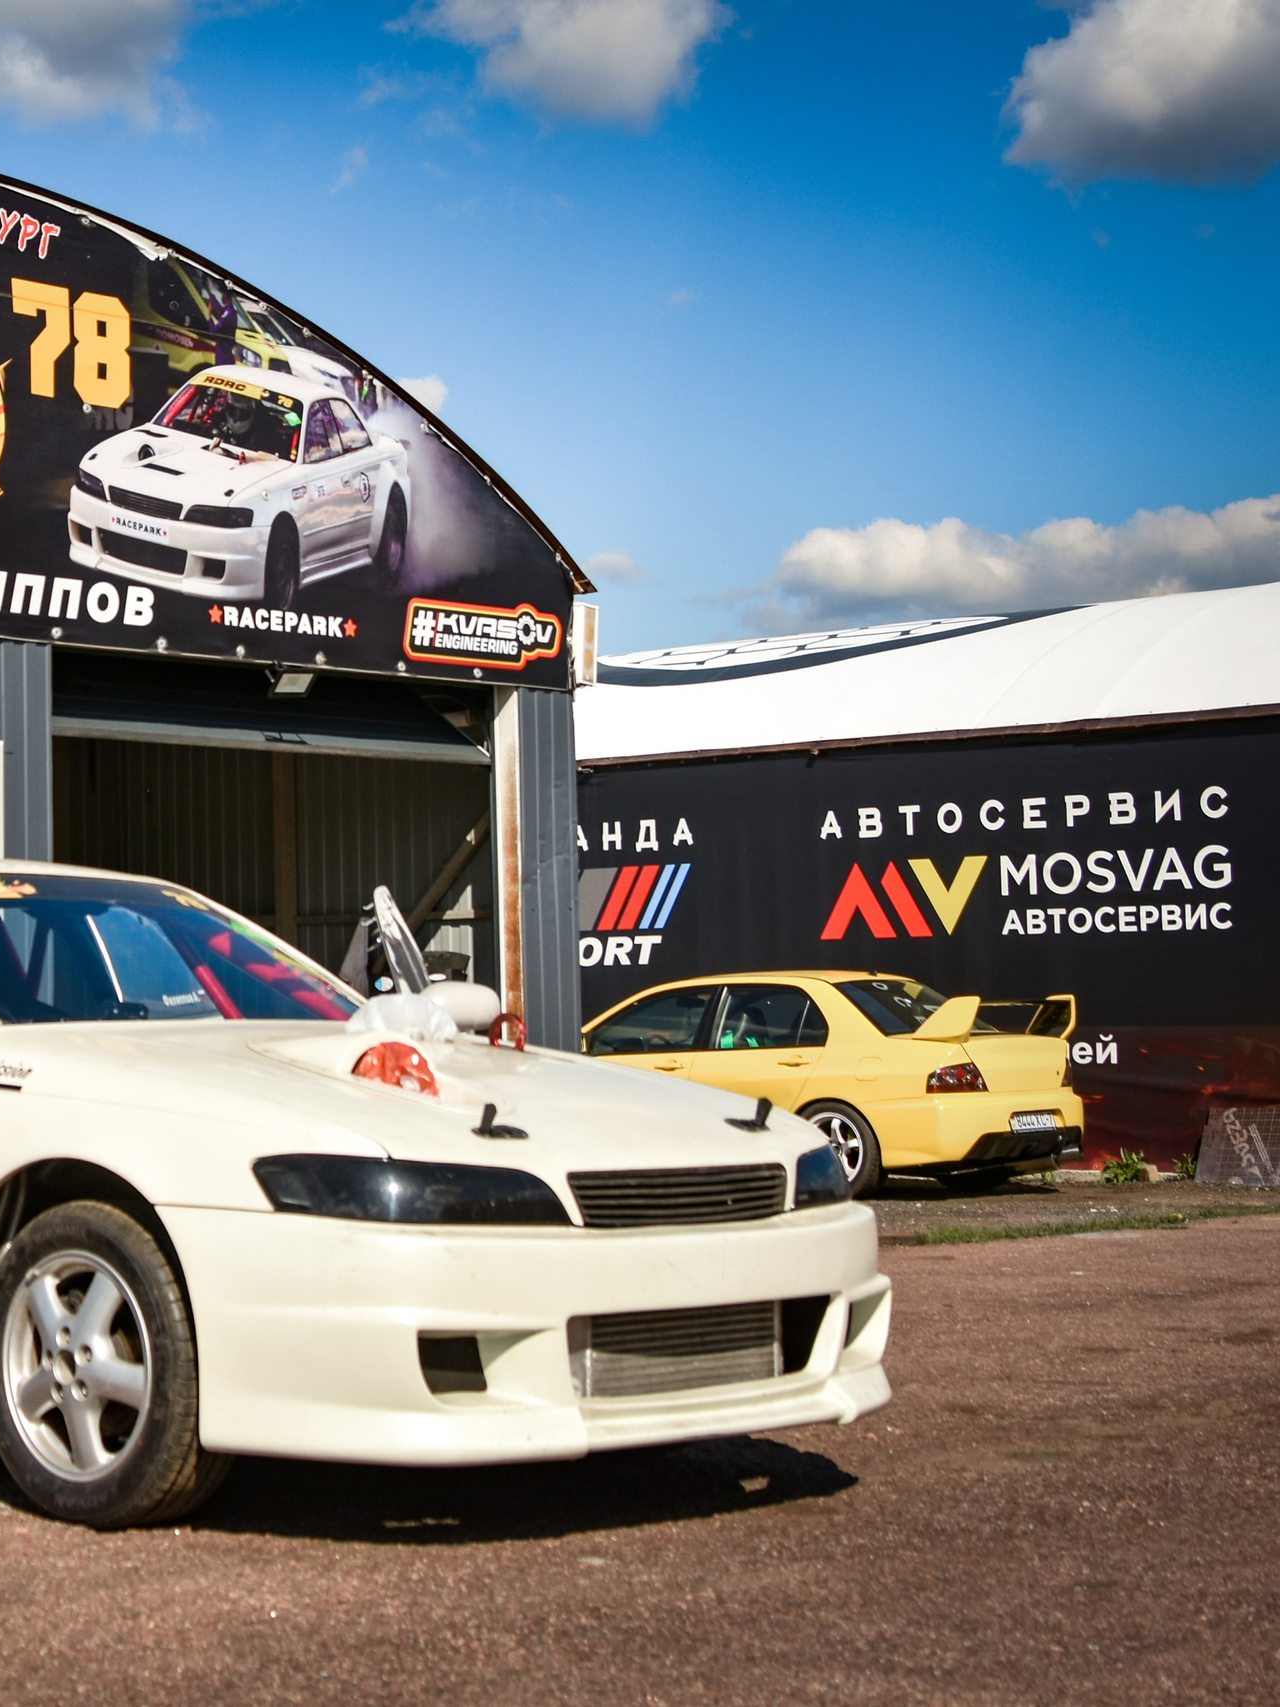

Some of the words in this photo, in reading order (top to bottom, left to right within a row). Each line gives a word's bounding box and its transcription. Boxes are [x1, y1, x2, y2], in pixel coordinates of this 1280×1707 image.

[11, 277, 131, 409] 78
[203, 374, 247, 392] RDRC
[277, 394, 294, 409] 78
[116, 517, 162, 537] RACEPARK
[223, 605, 345, 638] RACEPARK
[434, 632, 519, 656] ENGINEERING
[819, 785, 1229, 840] АВТОСЕРВИС
[999, 844, 1233, 897] MOSVAG
[1001, 902, 1233, 936] АВТОСЕРВИС
